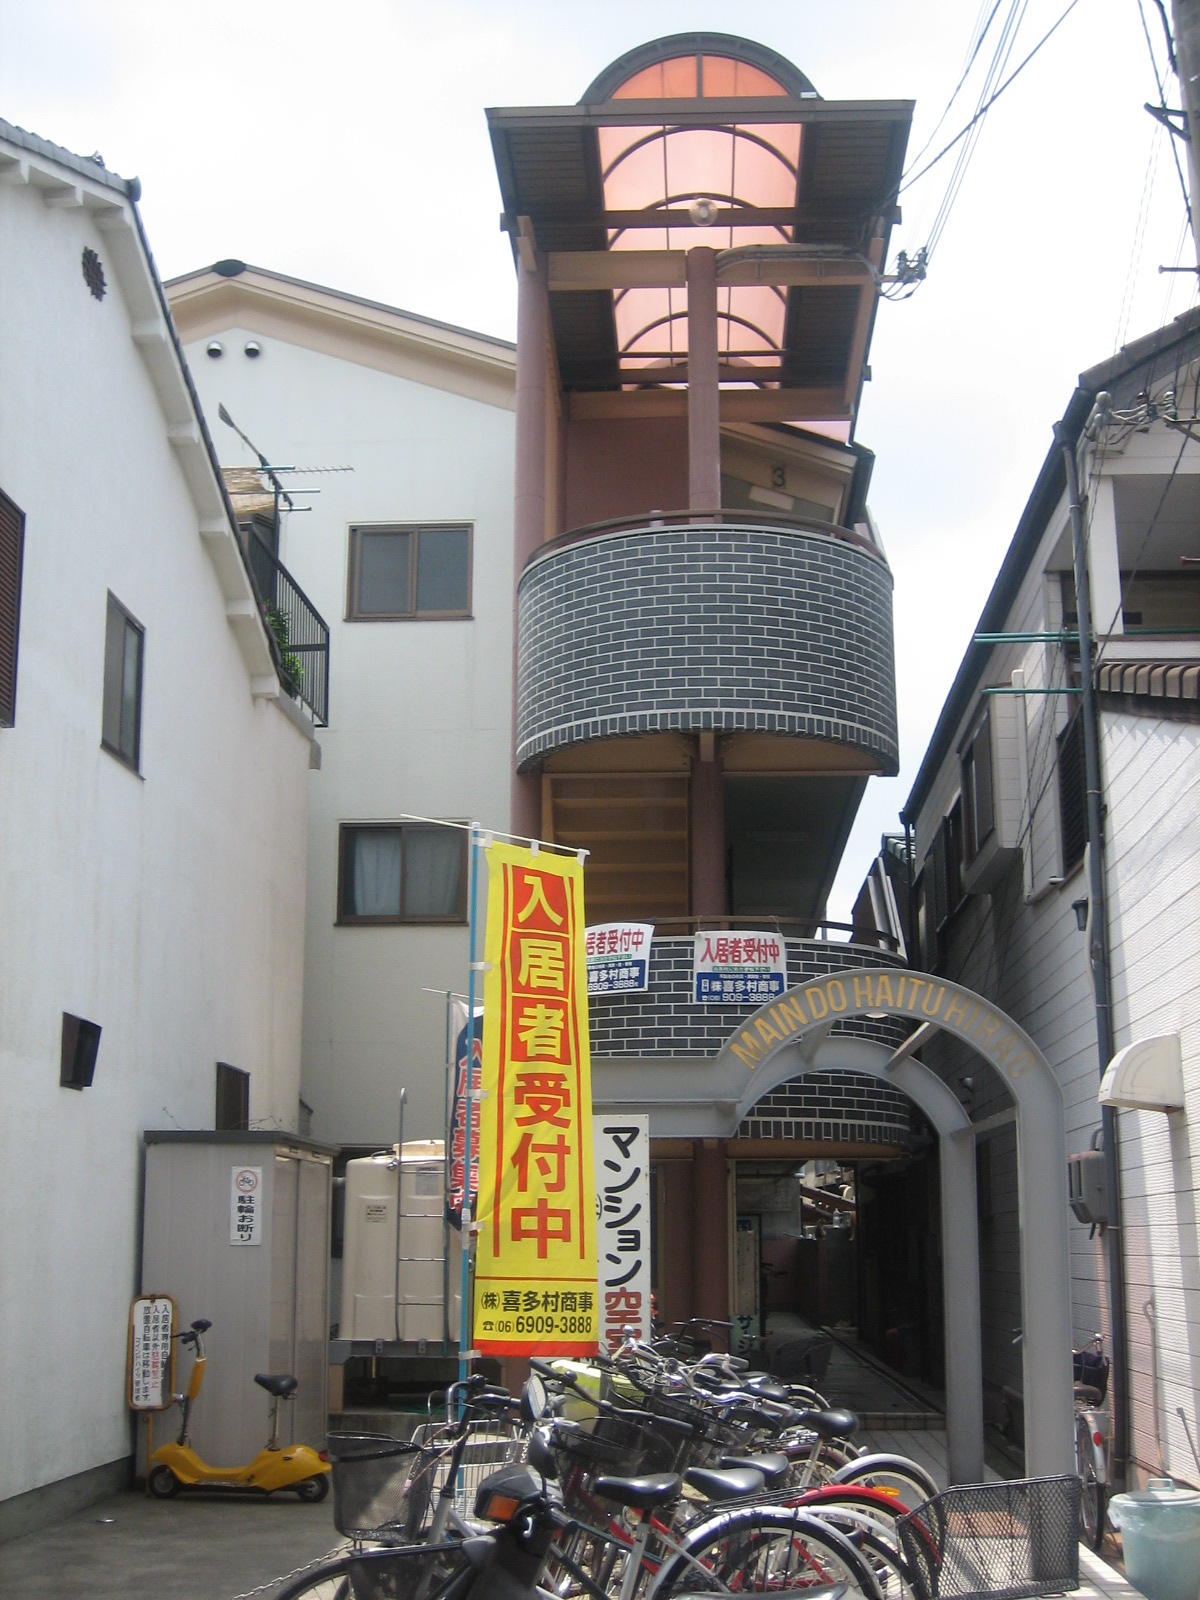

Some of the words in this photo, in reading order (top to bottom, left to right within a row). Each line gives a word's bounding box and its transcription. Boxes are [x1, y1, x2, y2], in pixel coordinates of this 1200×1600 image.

[773, 467, 785, 487] 3
[586, 928, 644, 956] 居者受付中
[700, 937, 780, 964] 入居者受付中
[587, 967, 640, 982] 喜多村商事
[730, 998, 809, 1070] MAIN
[805, 980, 847, 1018] DO
[853, 975, 945, 1016] HAITU
[943, 994, 1037, 1079] HIRAO
[511, 876, 571, 1259] 入居者受付中
[237, 1195, 255, 1242] 駐輪お断り
